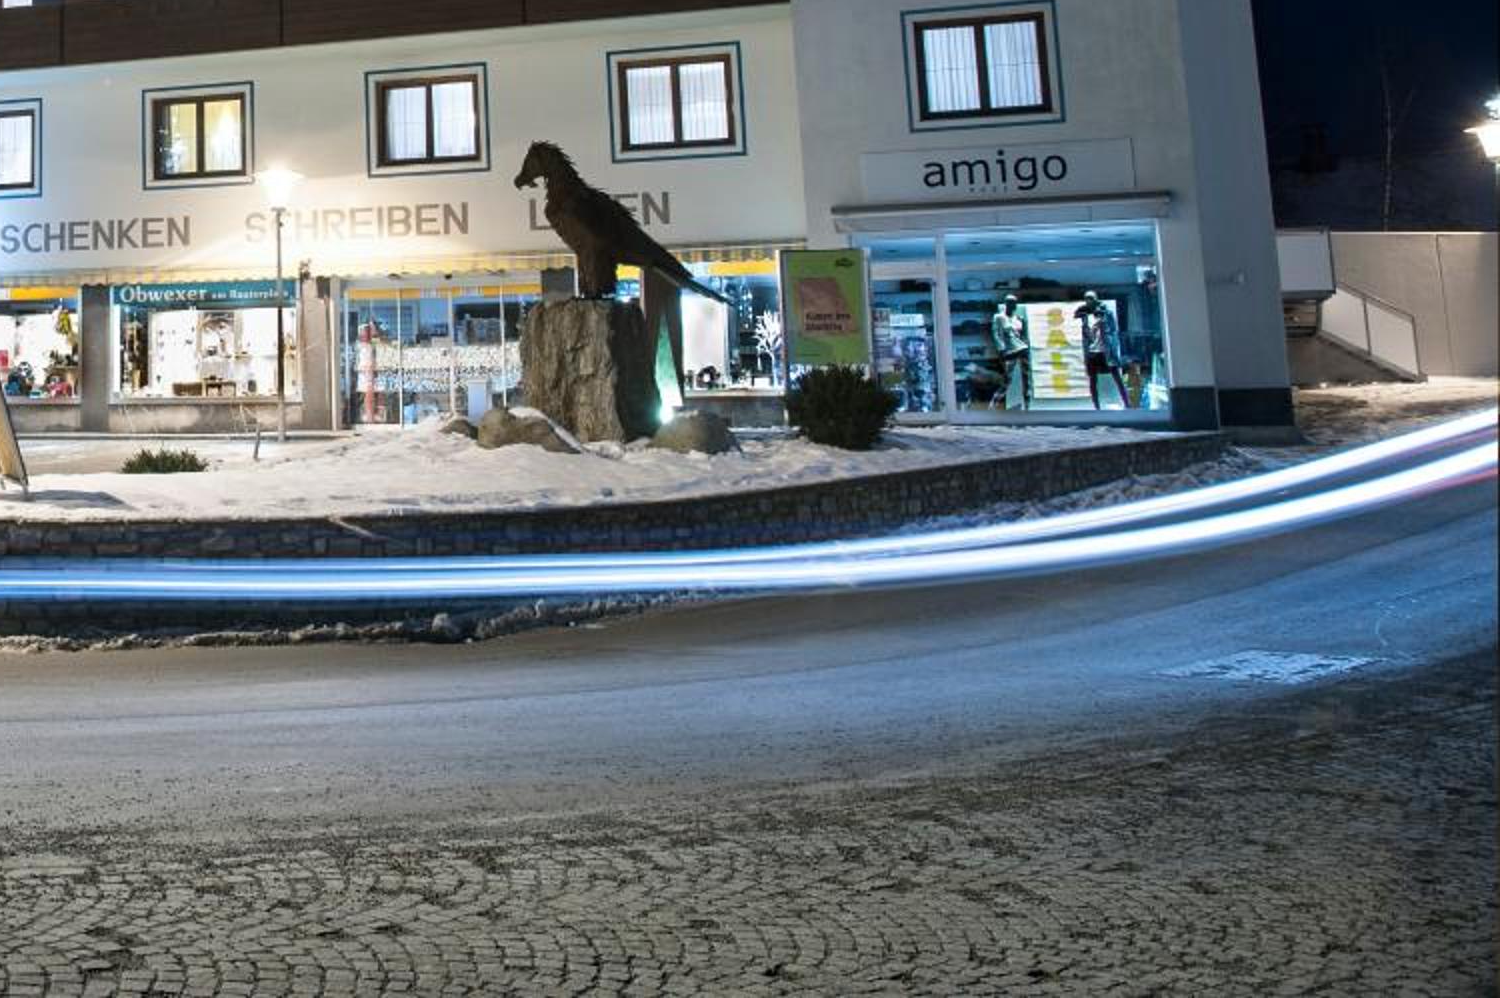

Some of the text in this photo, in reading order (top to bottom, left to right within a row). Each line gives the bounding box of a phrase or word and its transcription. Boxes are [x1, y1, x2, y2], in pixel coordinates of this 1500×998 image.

[923, 150, 1067, 190] amigo
[1, 216, 190, 253] SCHENKEN
[245, 202, 468, 243] SHREIBEN
[120, 285, 207, 302] Obwexer
